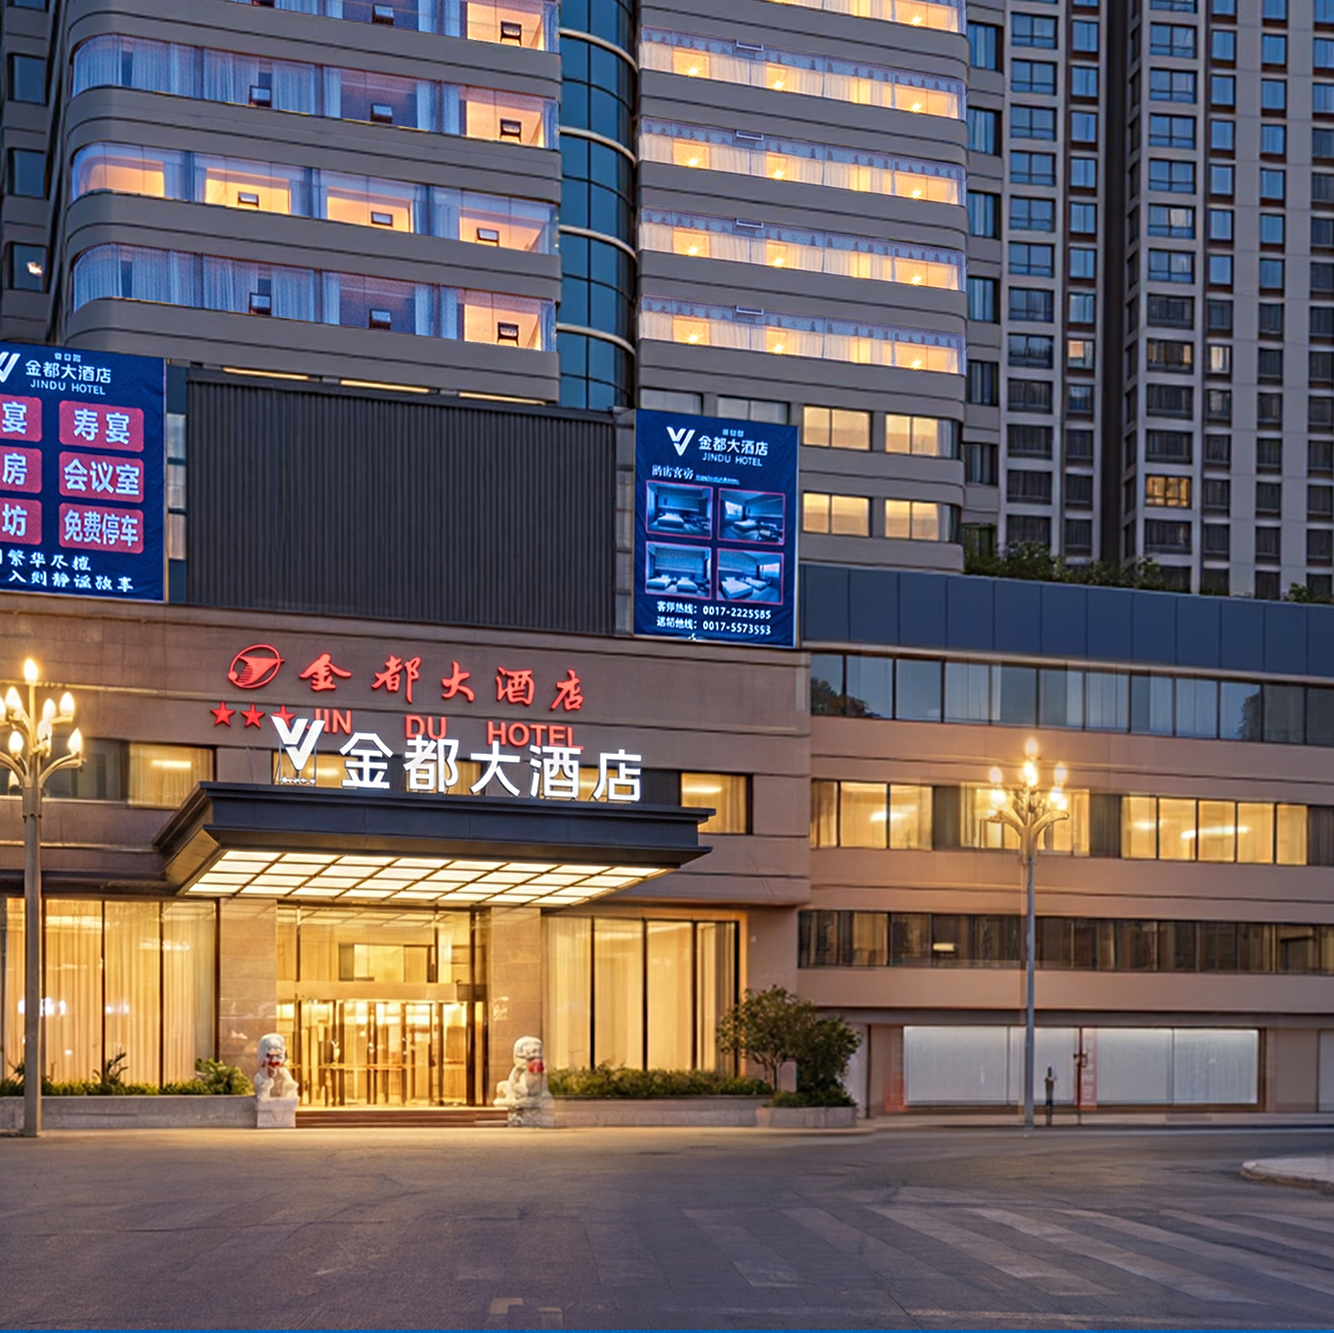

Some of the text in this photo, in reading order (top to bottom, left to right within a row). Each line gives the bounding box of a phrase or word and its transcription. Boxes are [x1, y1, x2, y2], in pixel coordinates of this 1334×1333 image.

[25, 359, 112, 384] 金都大酒店
[29, 378, 107, 396] JINDU HOTEL
[73, 408, 131, 445] 寿宴
[698, 434, 769, 457] 金都大酒店
[702, 452, 763, 467] JINDU HOTEL
[63, 458, 140, 496] 会议室
[63, 509, 139, 547] 免费停车
[298, 652, 586, 712] 金都大酒店
[404, 714, 448, 741] DU
[486, 720, 585, 752] HOTEL
[338, 732, 643, 803] 金都大酒店
